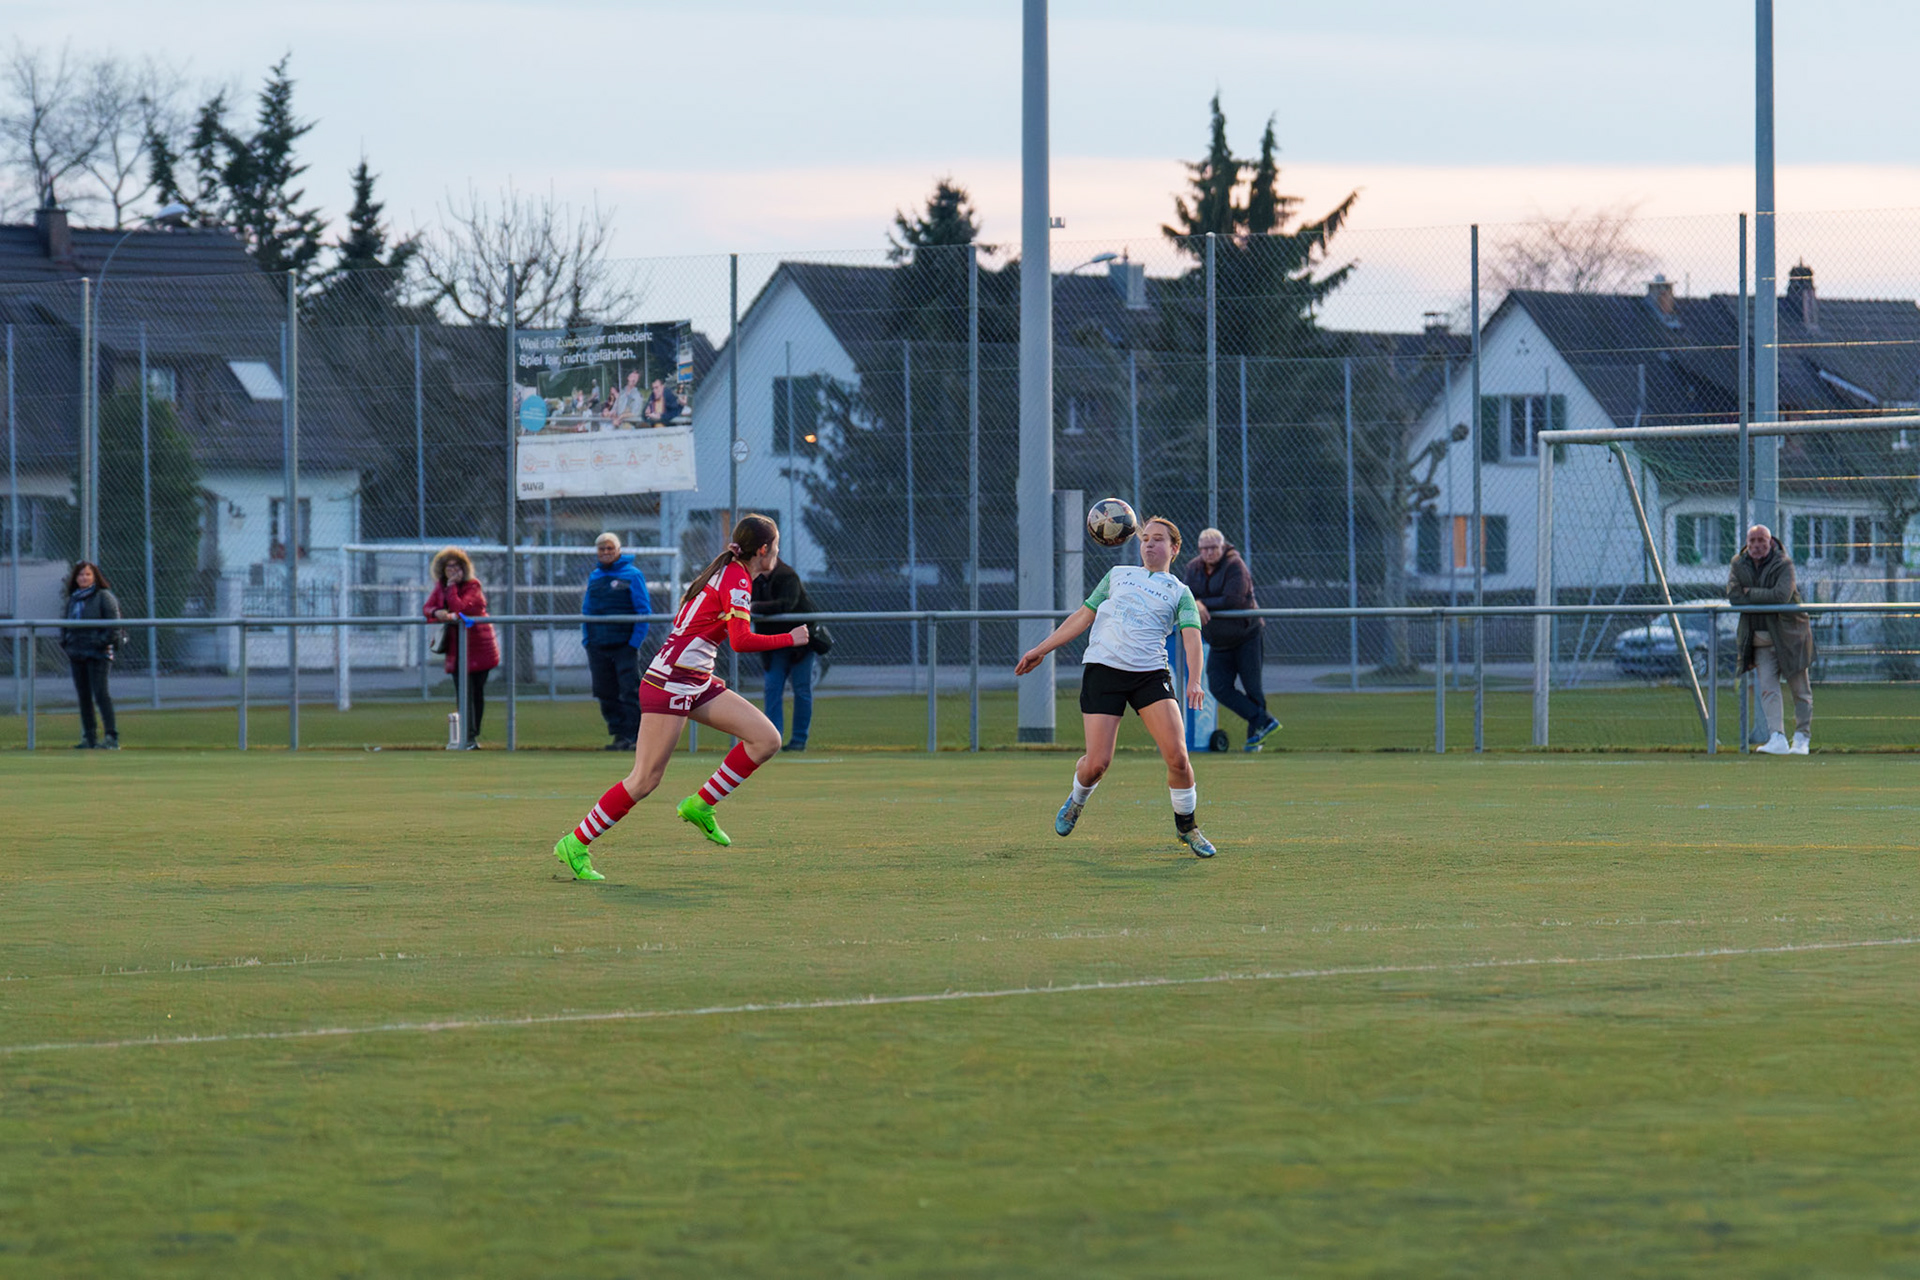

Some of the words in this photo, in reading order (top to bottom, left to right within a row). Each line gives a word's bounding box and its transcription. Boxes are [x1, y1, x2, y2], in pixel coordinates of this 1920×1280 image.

[519, 338, 540, 350] Weil
[541, 337, 555, 349] die
[556, 335, 605, 348] Zuschauer
[607, 331, 653, 344] mitleiden:
[519, 354, 542, 368] Spiel
[563, 352, 585, 364] nicht
[587, 348, 637, 365] gefährlich.
[521, 482, 545, 492] suva
